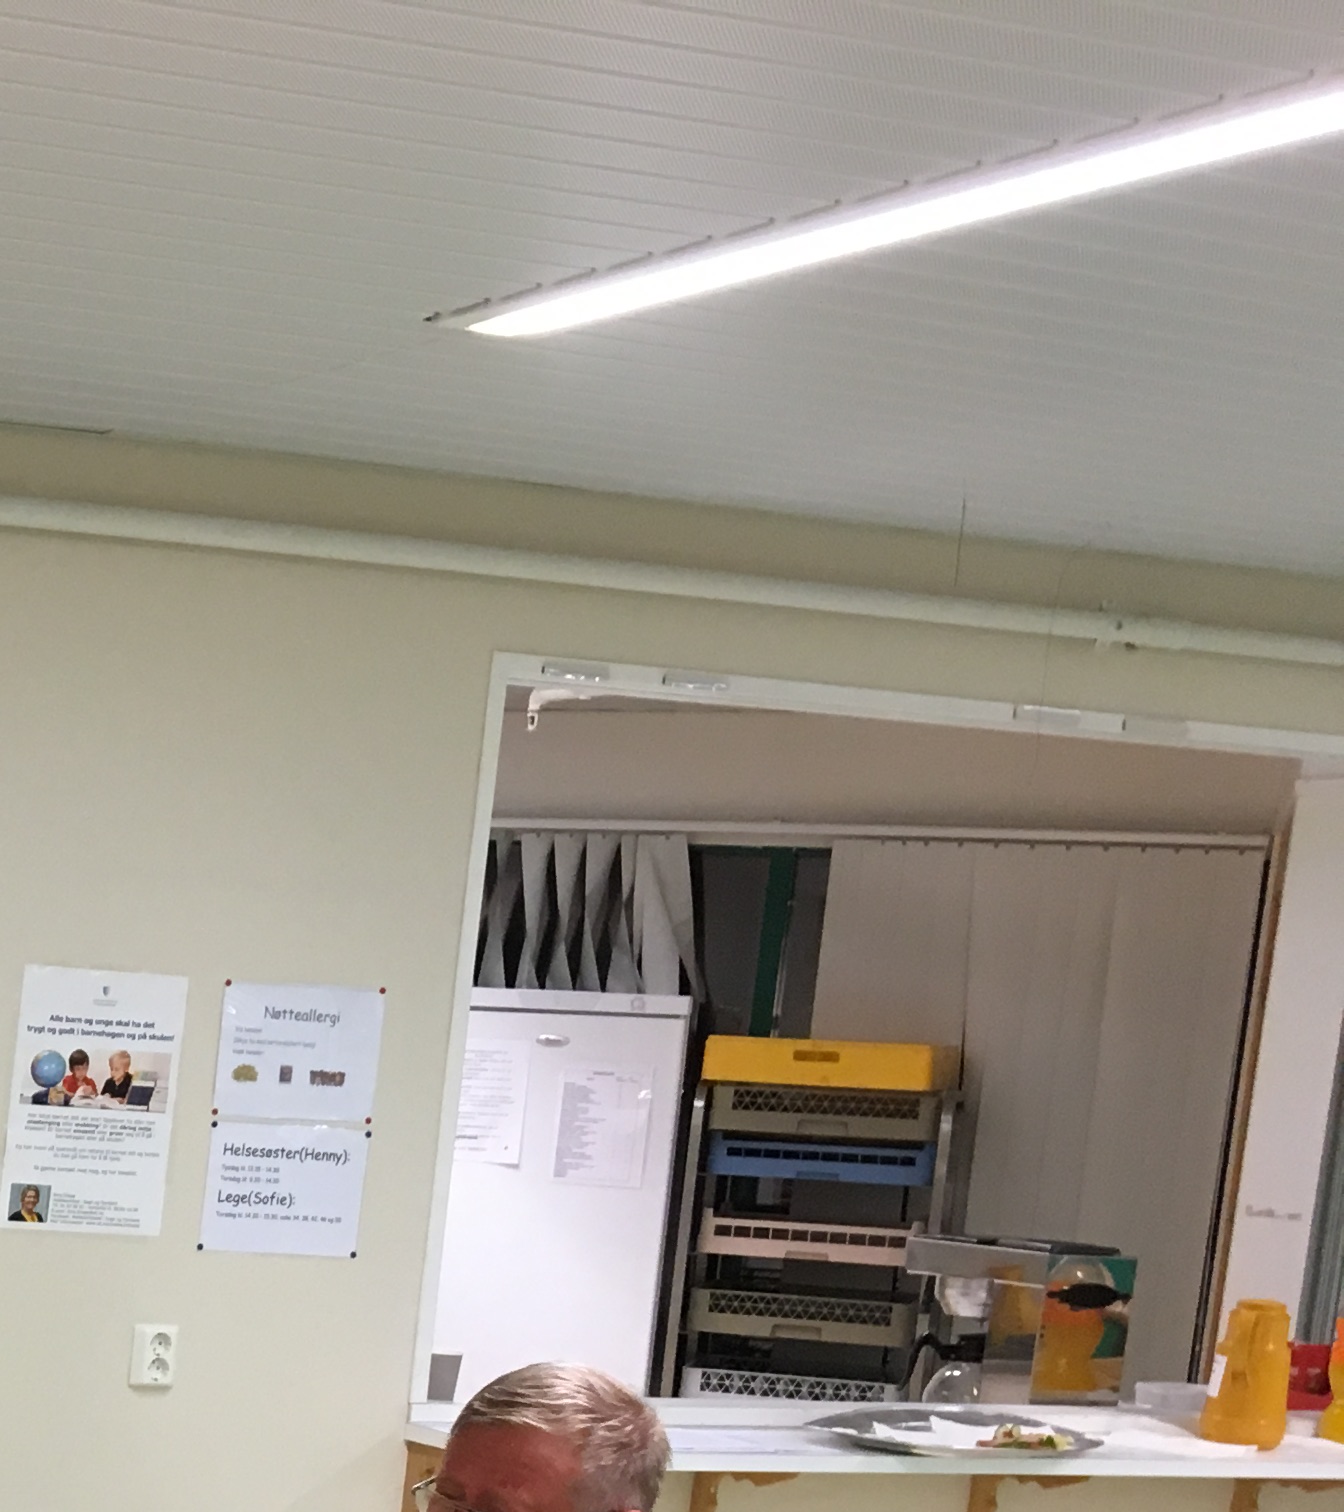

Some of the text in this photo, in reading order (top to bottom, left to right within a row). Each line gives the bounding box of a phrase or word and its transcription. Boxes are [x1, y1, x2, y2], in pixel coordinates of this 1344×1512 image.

[264, 1006, 341, 1027] Nøtteallergi
[223, 1142, 351, 1166] Helsesøster(Henny):
[217, 1189, 296, 1209] Lege(Sofie):
